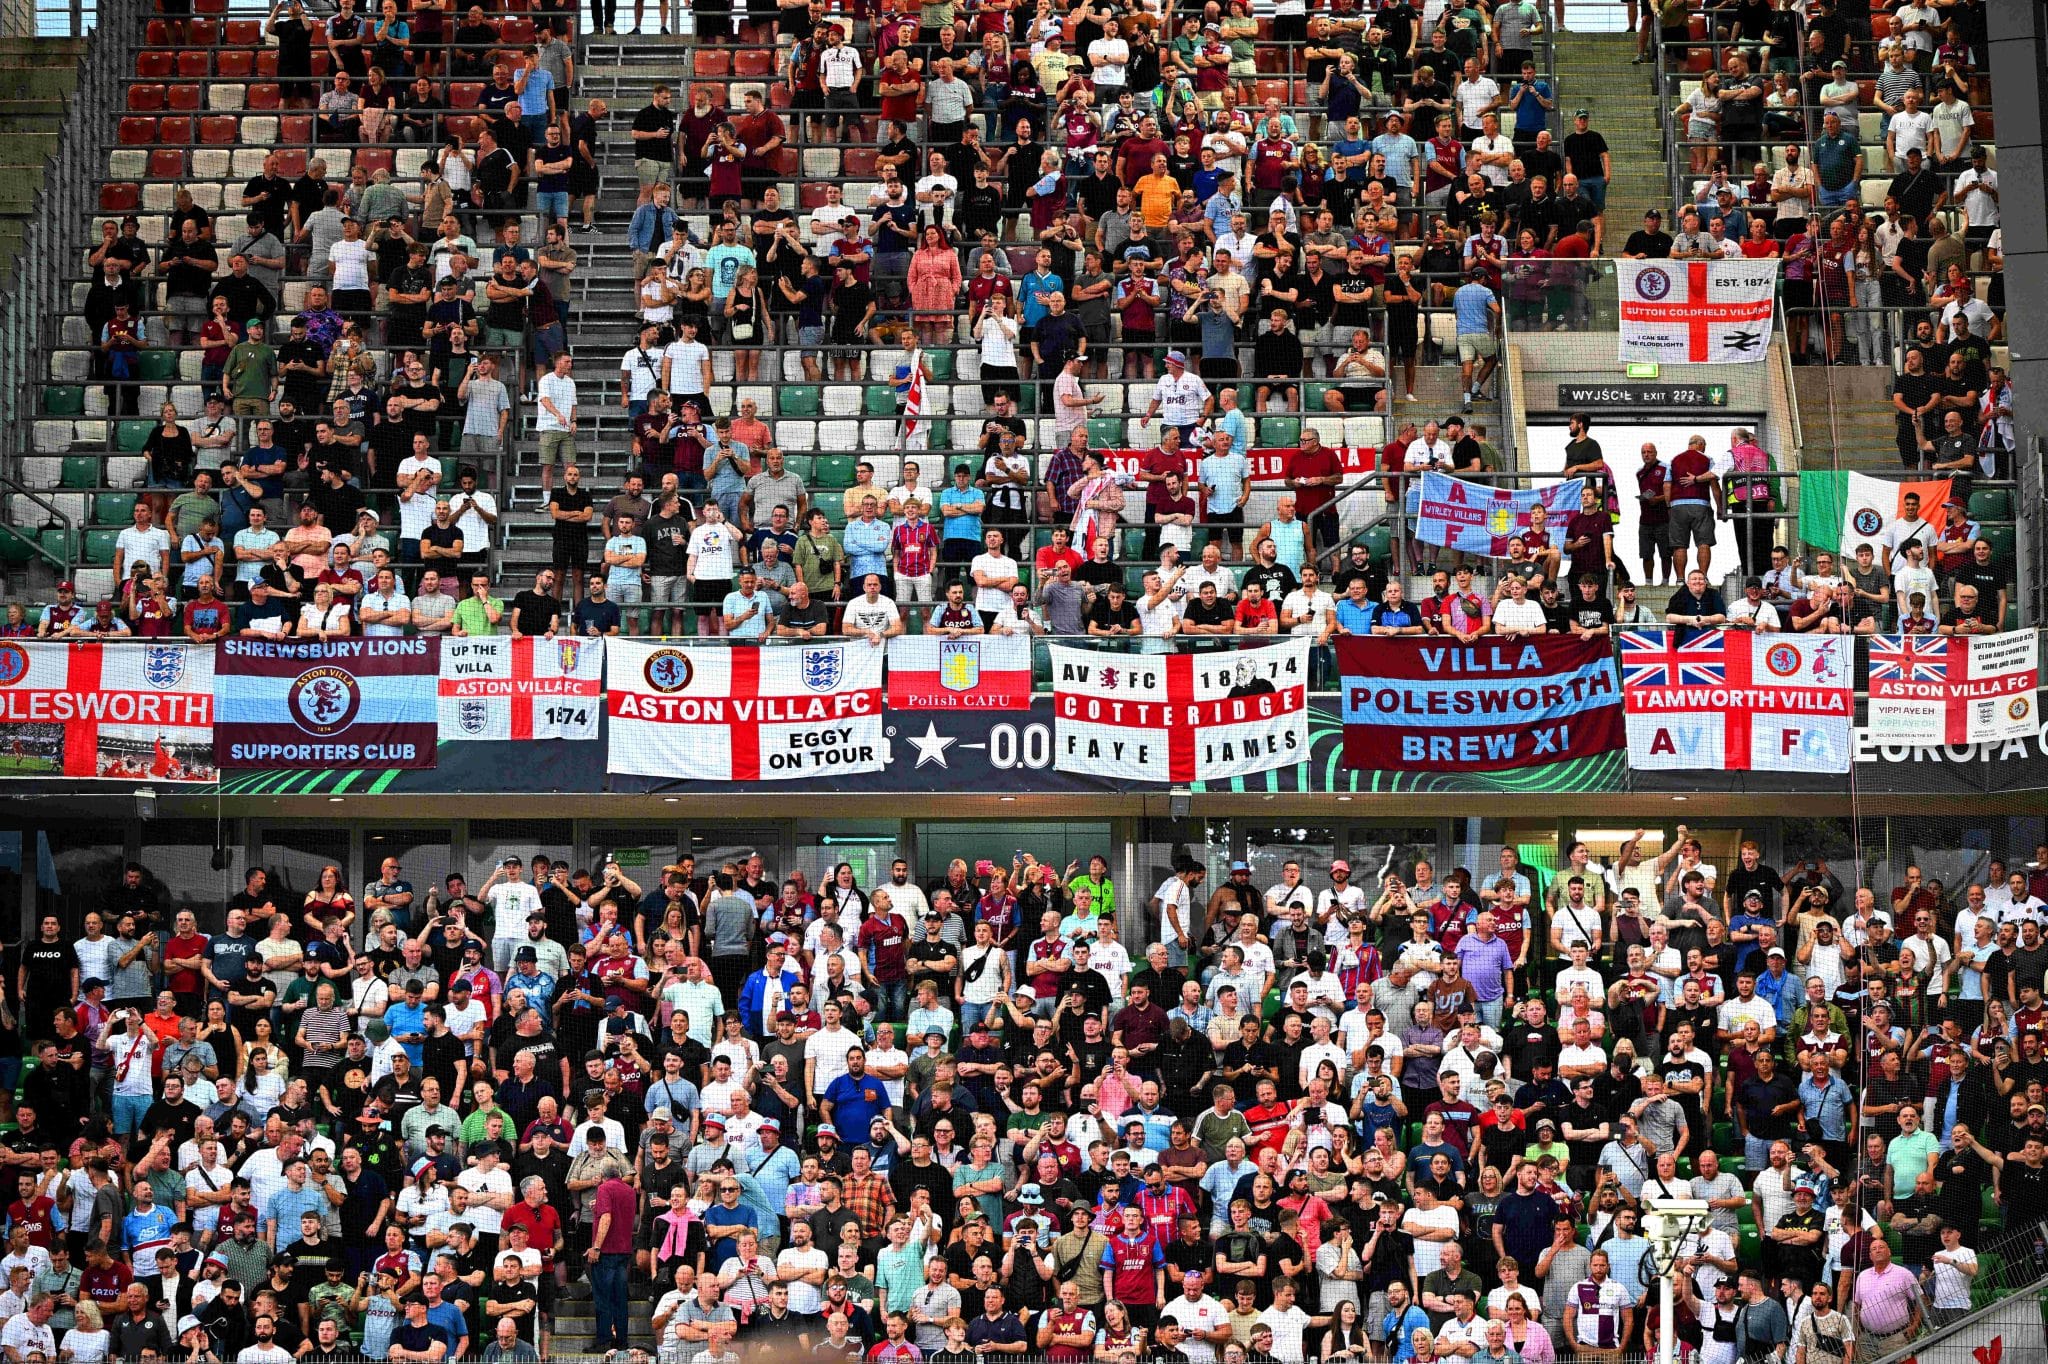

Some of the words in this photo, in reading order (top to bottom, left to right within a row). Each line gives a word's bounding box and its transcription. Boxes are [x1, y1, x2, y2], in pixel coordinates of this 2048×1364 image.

[1715, 279, 1739, 287] EST.
[1743, 278, 1770, 287] 1874
[1626, 307, 1666, 316] SUTTON
[1669, 308, 1727, 317] COLDFIELD
[1730, 304, 1770, 317] VILLANS
[1424, 505, 1453, 517] WYRLEY
[1454, 510, 1482, 522] VILLANS
[225, 639, 362, 659] SHREWSBURY
[368, 639, 427, 656] LIONS
[451, 646, 469, 656] UP
[473, 645, 497, 655] THE
[943, 643, 978, 655] AVFC
[1973, 640, 1995, 651] SUTTON
[1996, 635, 2023, 648] COLDFIELD
[1420, 644, 1543, 672] VILLA
[1978, 652, 1991, 661] CLUB
[1992, 650, 2004, 659] AND
[2004, 645, 2030, 657] COUNTRY
[455, 663, 493, 674] VILLA
[1063, 664, 1090, 683] AV
[1129, 671, 1156, 690] FC
[1201, 669, 1231, 689] 18
[1269, 656, 1297, 679] 74
[1981, 661, 1998, 671] HOME
[1998, 660, 2009, 668] AND
[2009, 657, 2026, 667] AWAY
[297, 669, 326, 687] ASTON
[329, 669, 354, 687] VILLA
[456, 681, 513, 694] ASTON
[1879, 683, 1944, 697] ASTON
[1950, 681, 2001, 697] VILLA
[2007, 676, 2028, 691] FC
[908, 694, 958, 707] Polish
[963, 694, 1011, 707] CAFU
[1350, 669, 1613, 714] POLESWORTH
[1632, 689, 1776, 709] TAMWORTH
[1779, 691, 1845, 711] VILLA
[0, 690, 207, 723] LESWORTH
[618, 694, 724, 721] ASTON
[731, 694, 831, 721] VILLA
[834, 692, 871, 714] FC
[1064, 690, 1294, 727] COTTERIDGE
[1879, 706, 1902, 714] YIPPI
[1903, 706, 1921, 715] AYE
[1922, 707, 1935, 715] EH
[545, 707, 588, 726] 1874
[790, 728, 853, 749] EGGY
[990, 723, 1051, 769] 0.0
[1067, 735, 1149, 763] FAYE
[1205, 730, 1297, 763] JAMES
[1402, 733, 1517, 761] BREW
[1533, 725, 1570, 755] XI
[231, 744, 360, 760] SUPPORTERS
[364, 743, 416, 760] CLUB
[769, 752, 803, 769] ON
[809, 746, 873, 766] TOUR
